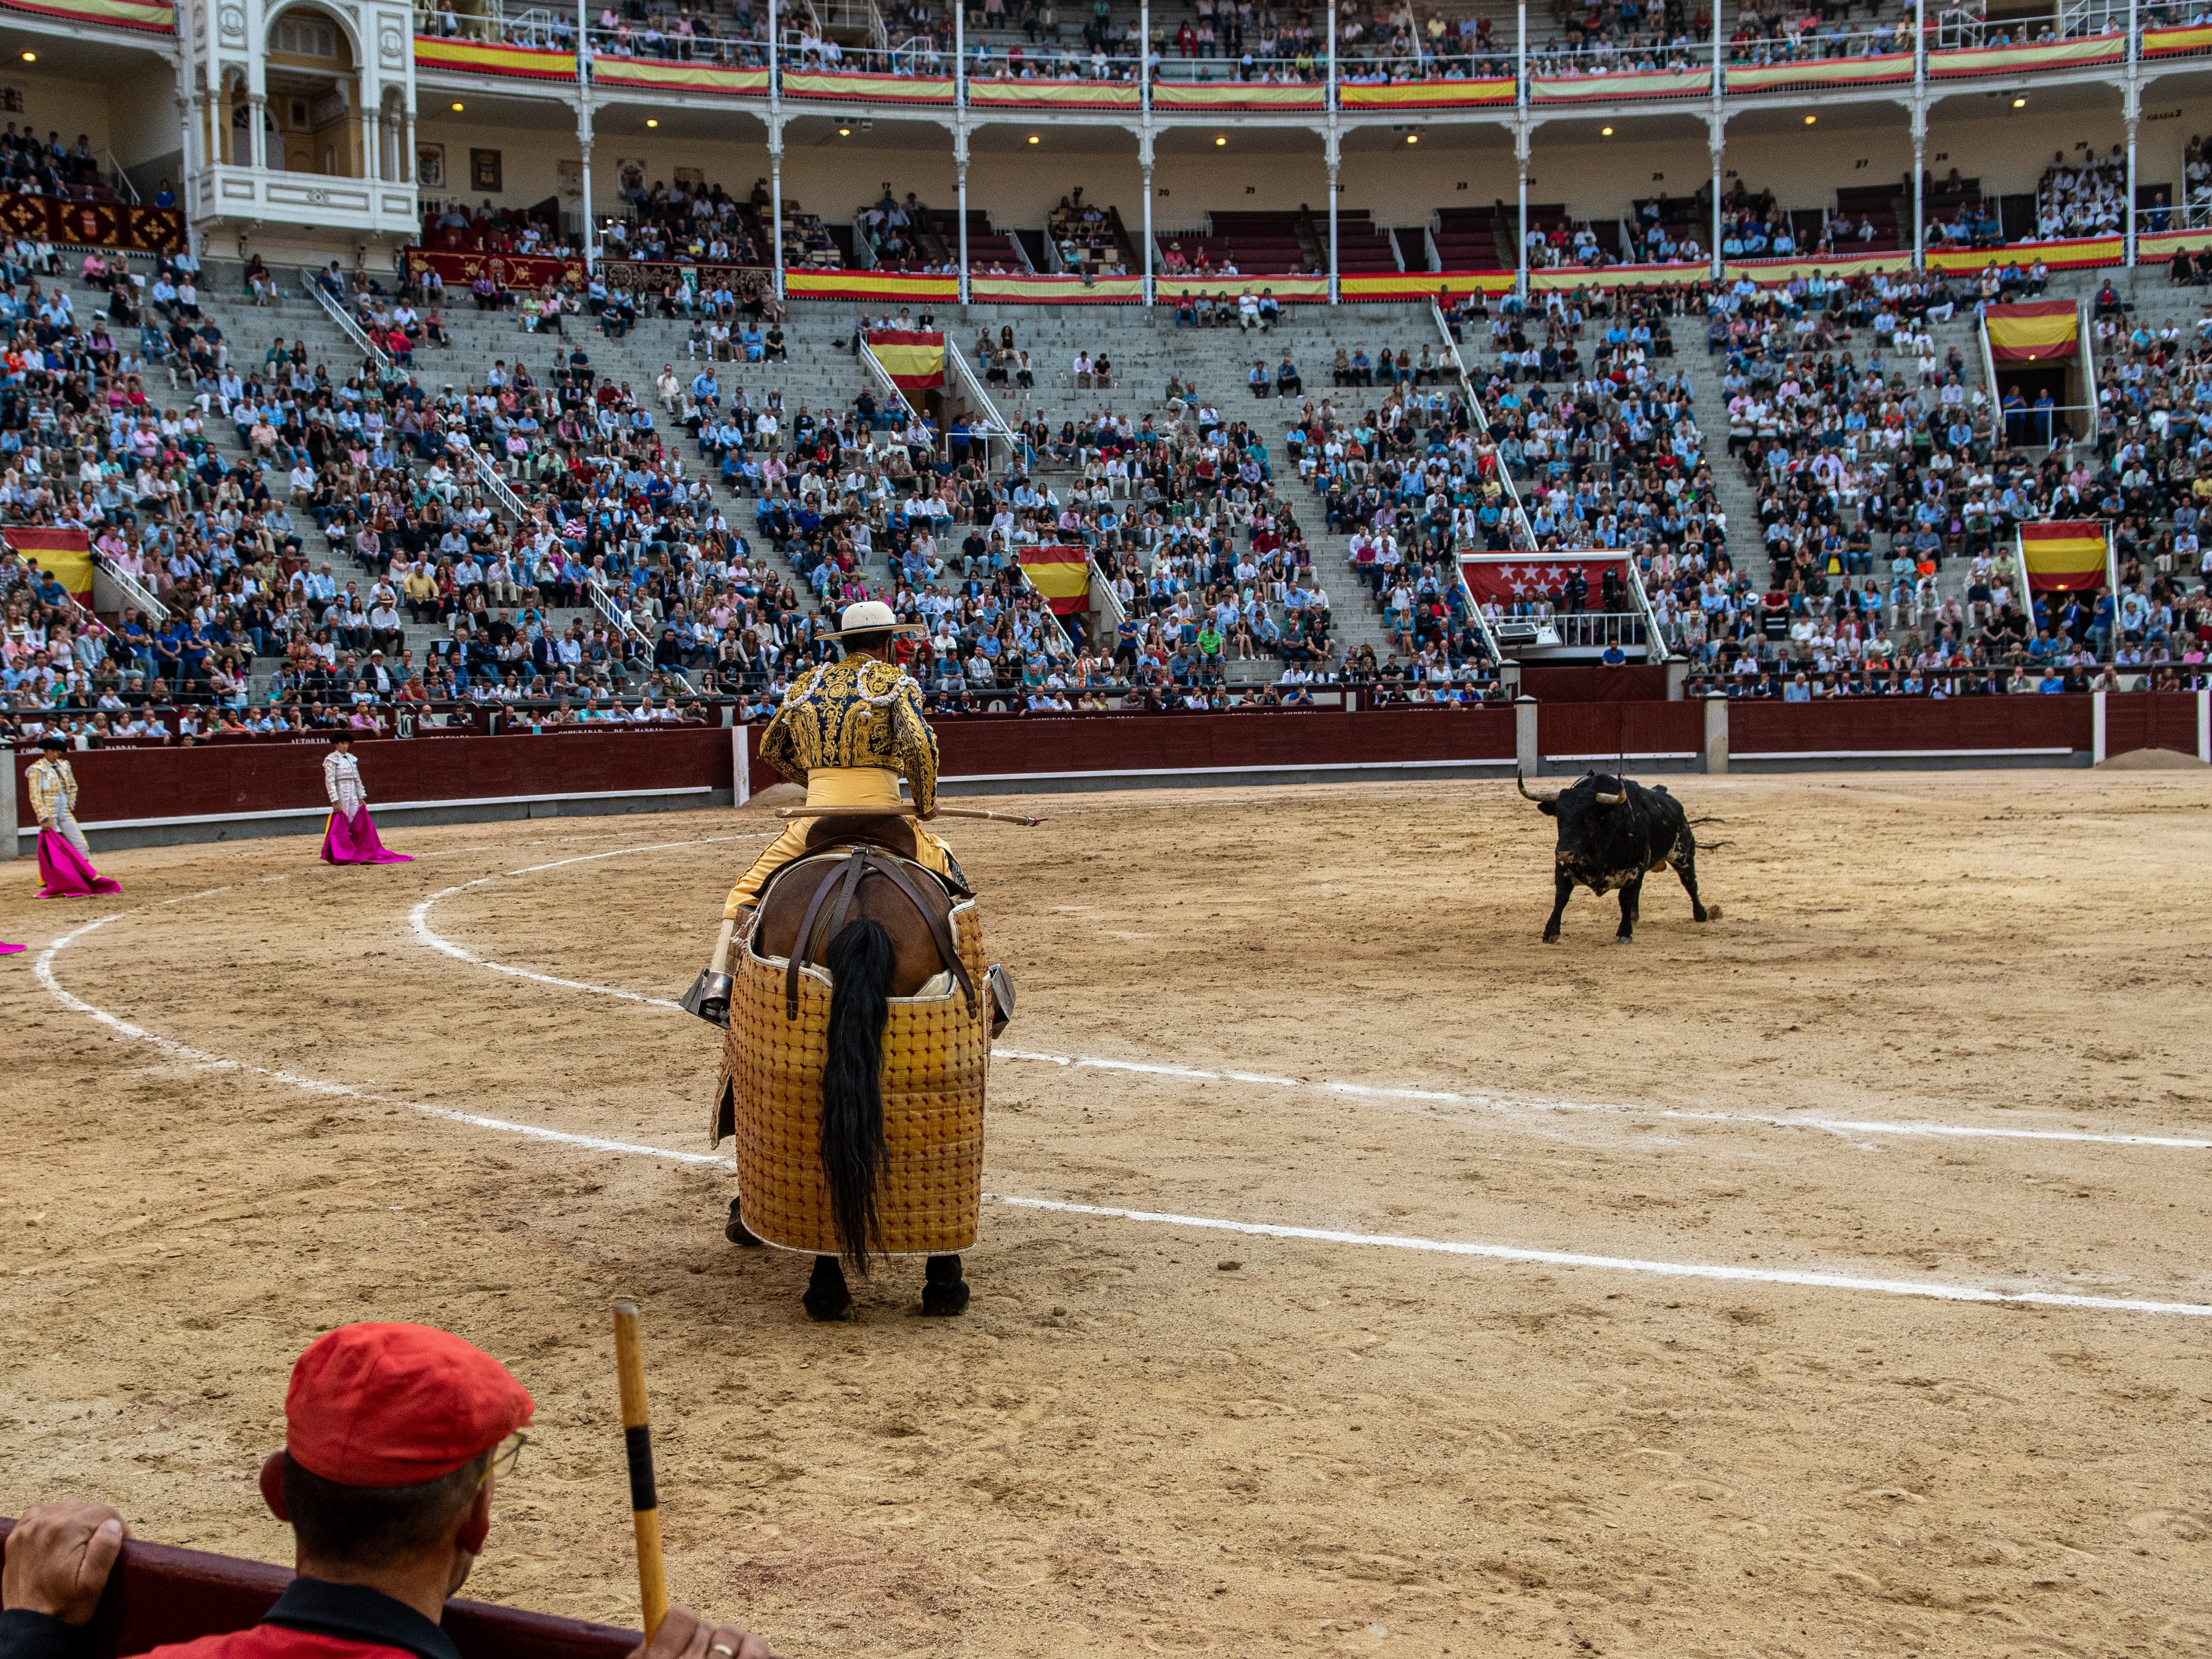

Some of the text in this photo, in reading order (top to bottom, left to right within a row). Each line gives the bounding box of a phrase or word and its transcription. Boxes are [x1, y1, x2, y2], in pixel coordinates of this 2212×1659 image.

[2176, 109, 2182, 117] 2
[2075, 141, 2088, 150] 29
[1856, 159, 1868, 168] 27
[1726, 169, 1737, 177] 26
[882, 182, 891, 190] 17
[1457, 182, 1467, 190] 23
[401, 715, 413, 735] 10
